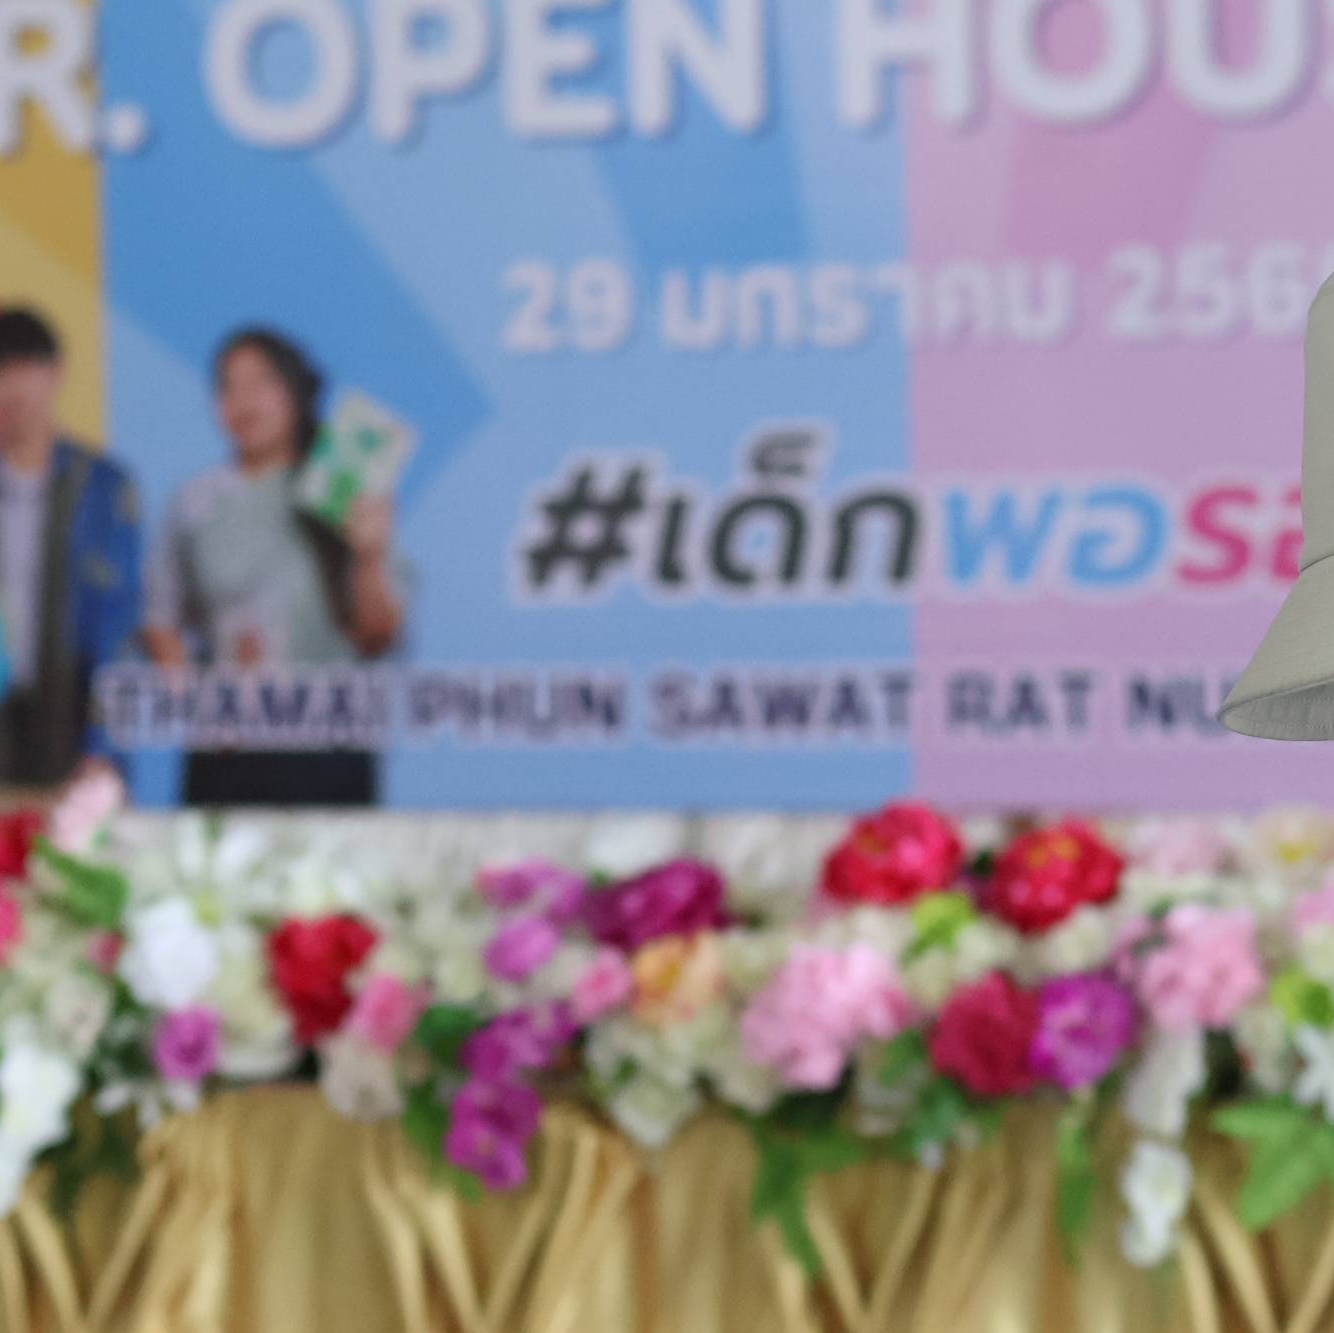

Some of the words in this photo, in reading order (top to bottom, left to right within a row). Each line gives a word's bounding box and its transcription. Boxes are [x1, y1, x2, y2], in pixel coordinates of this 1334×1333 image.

[204, 0, 767, 147] OPEN
[501, 258, 633, 352] 29
[409, 668, 625, 738] PHUN
[651, 668, 913, 736] SAWAT
[943, 668, 1097, 734] RAT
